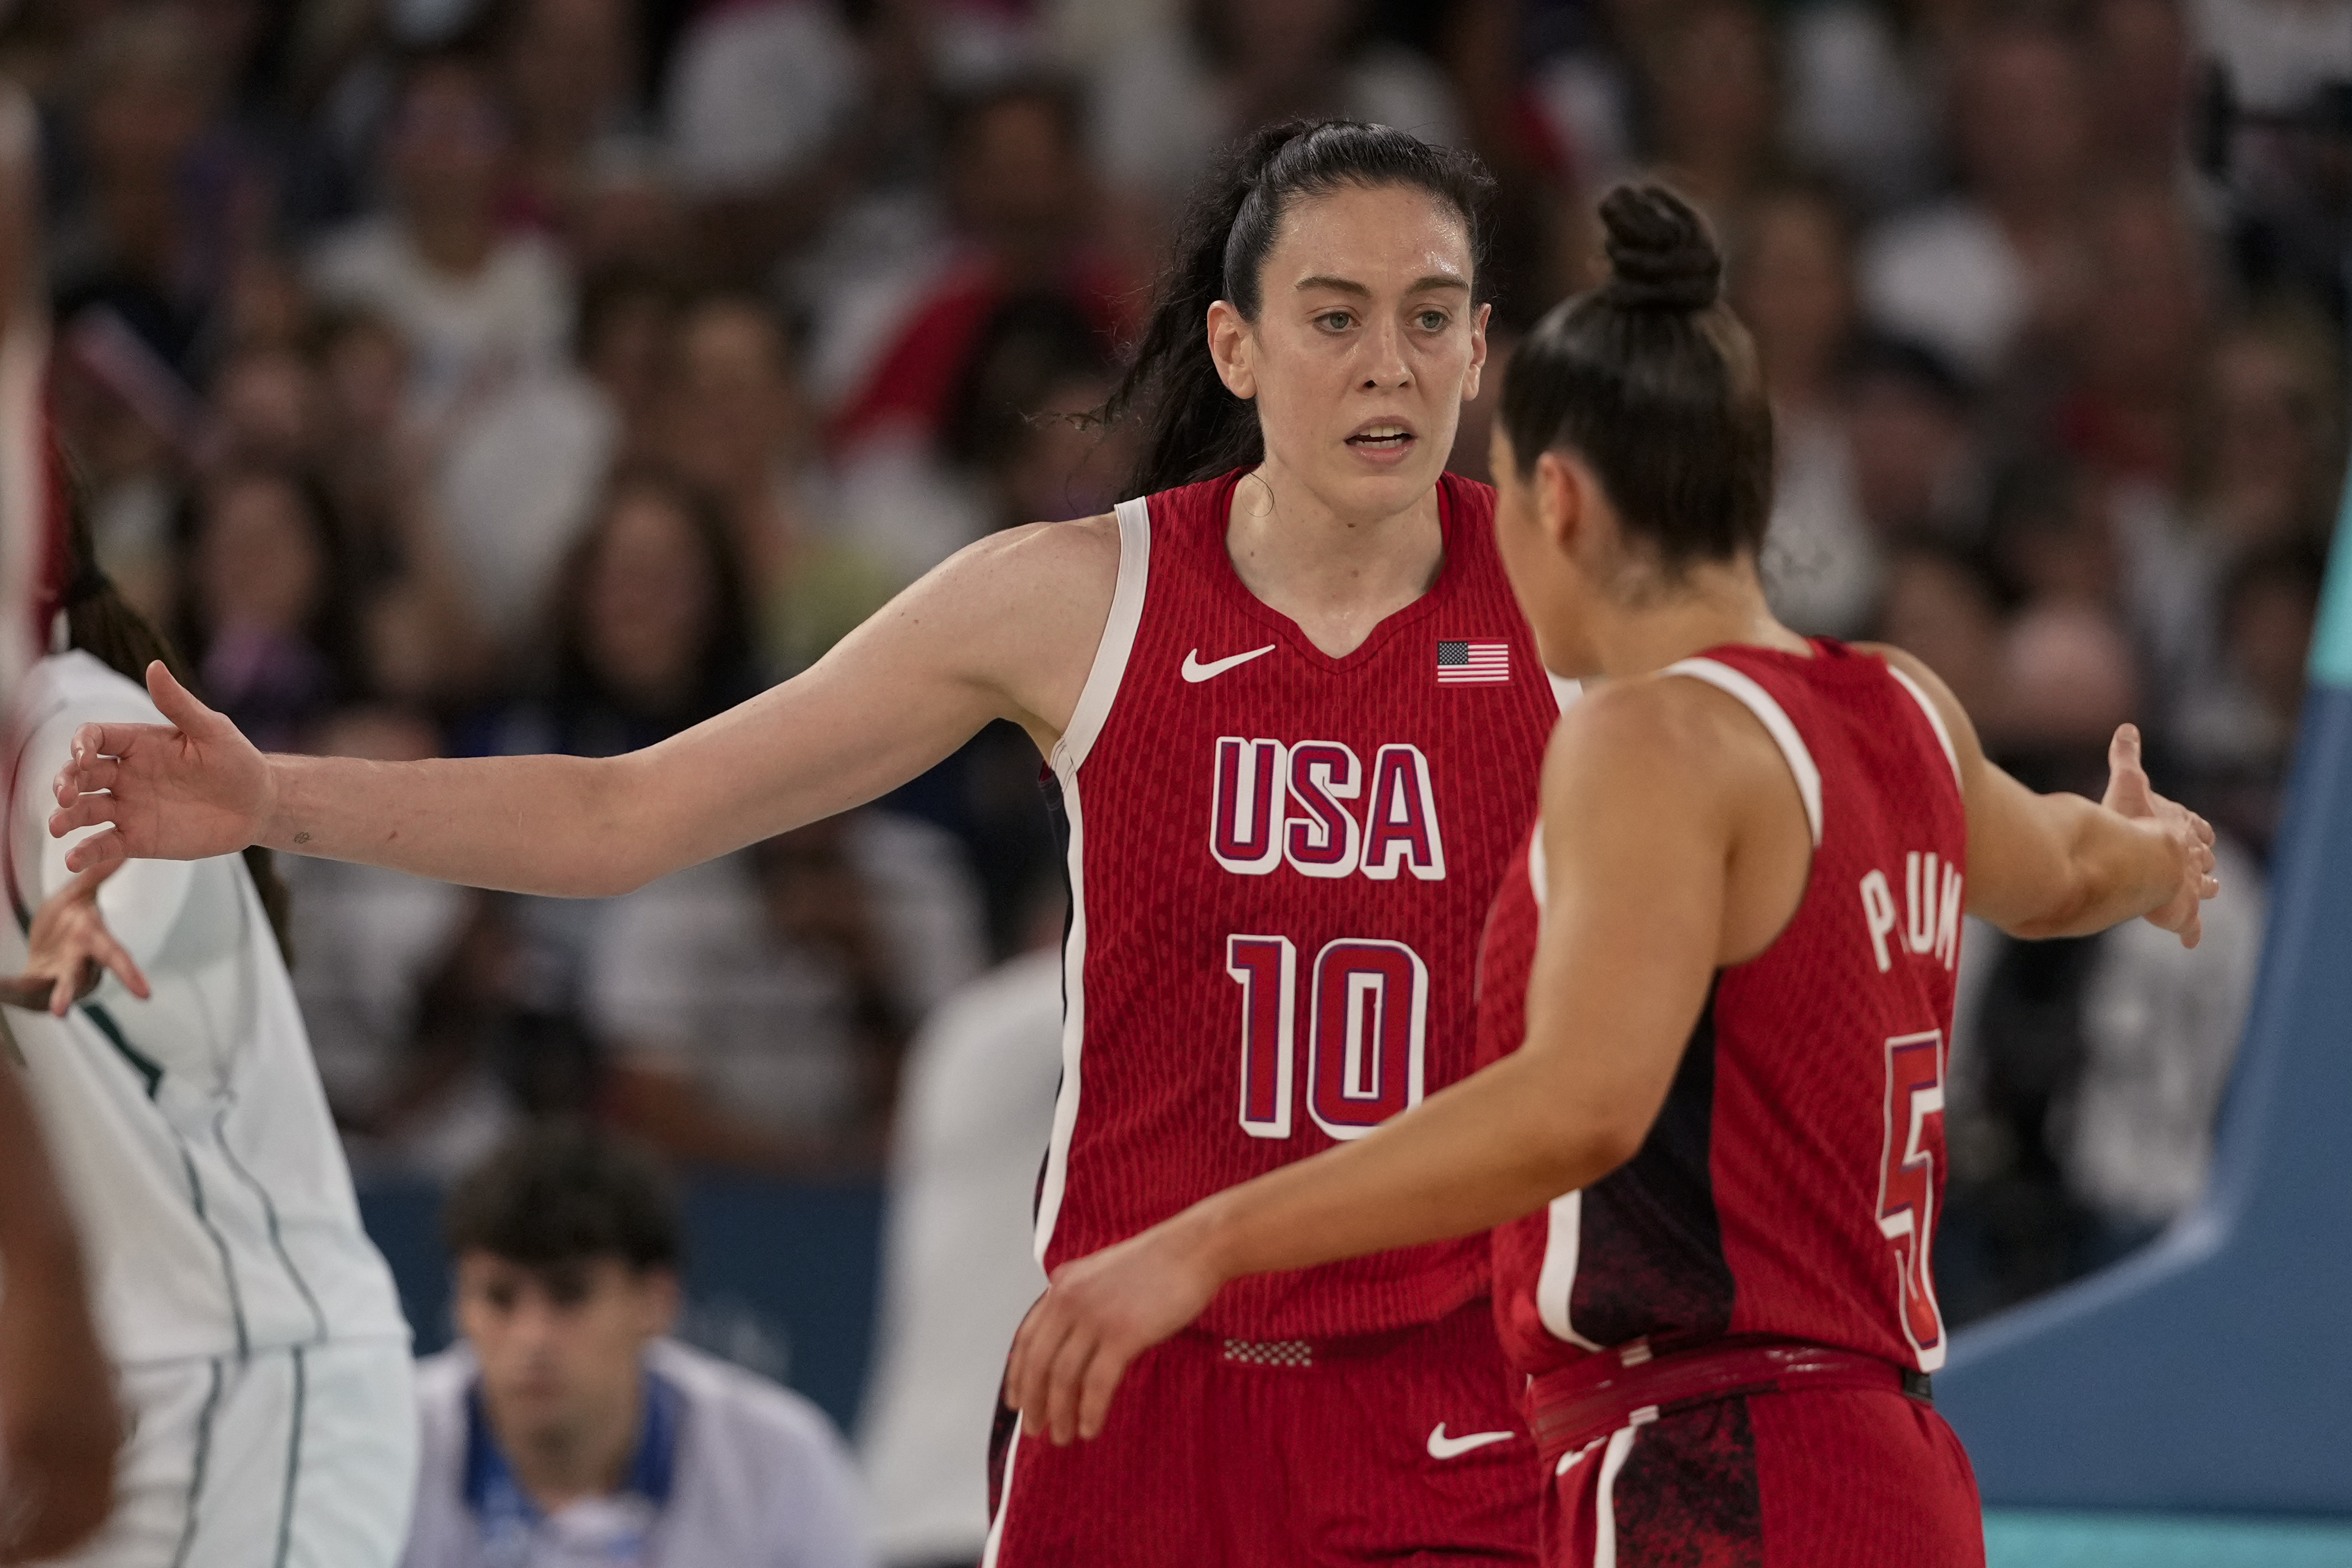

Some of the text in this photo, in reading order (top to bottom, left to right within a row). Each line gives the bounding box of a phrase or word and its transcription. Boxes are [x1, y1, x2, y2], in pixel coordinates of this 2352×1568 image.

[1210, 736, 1446, 881] USA
[1227, 934, 1428, 1141] 10
[1876, 1028, 1947, 1373] 5
